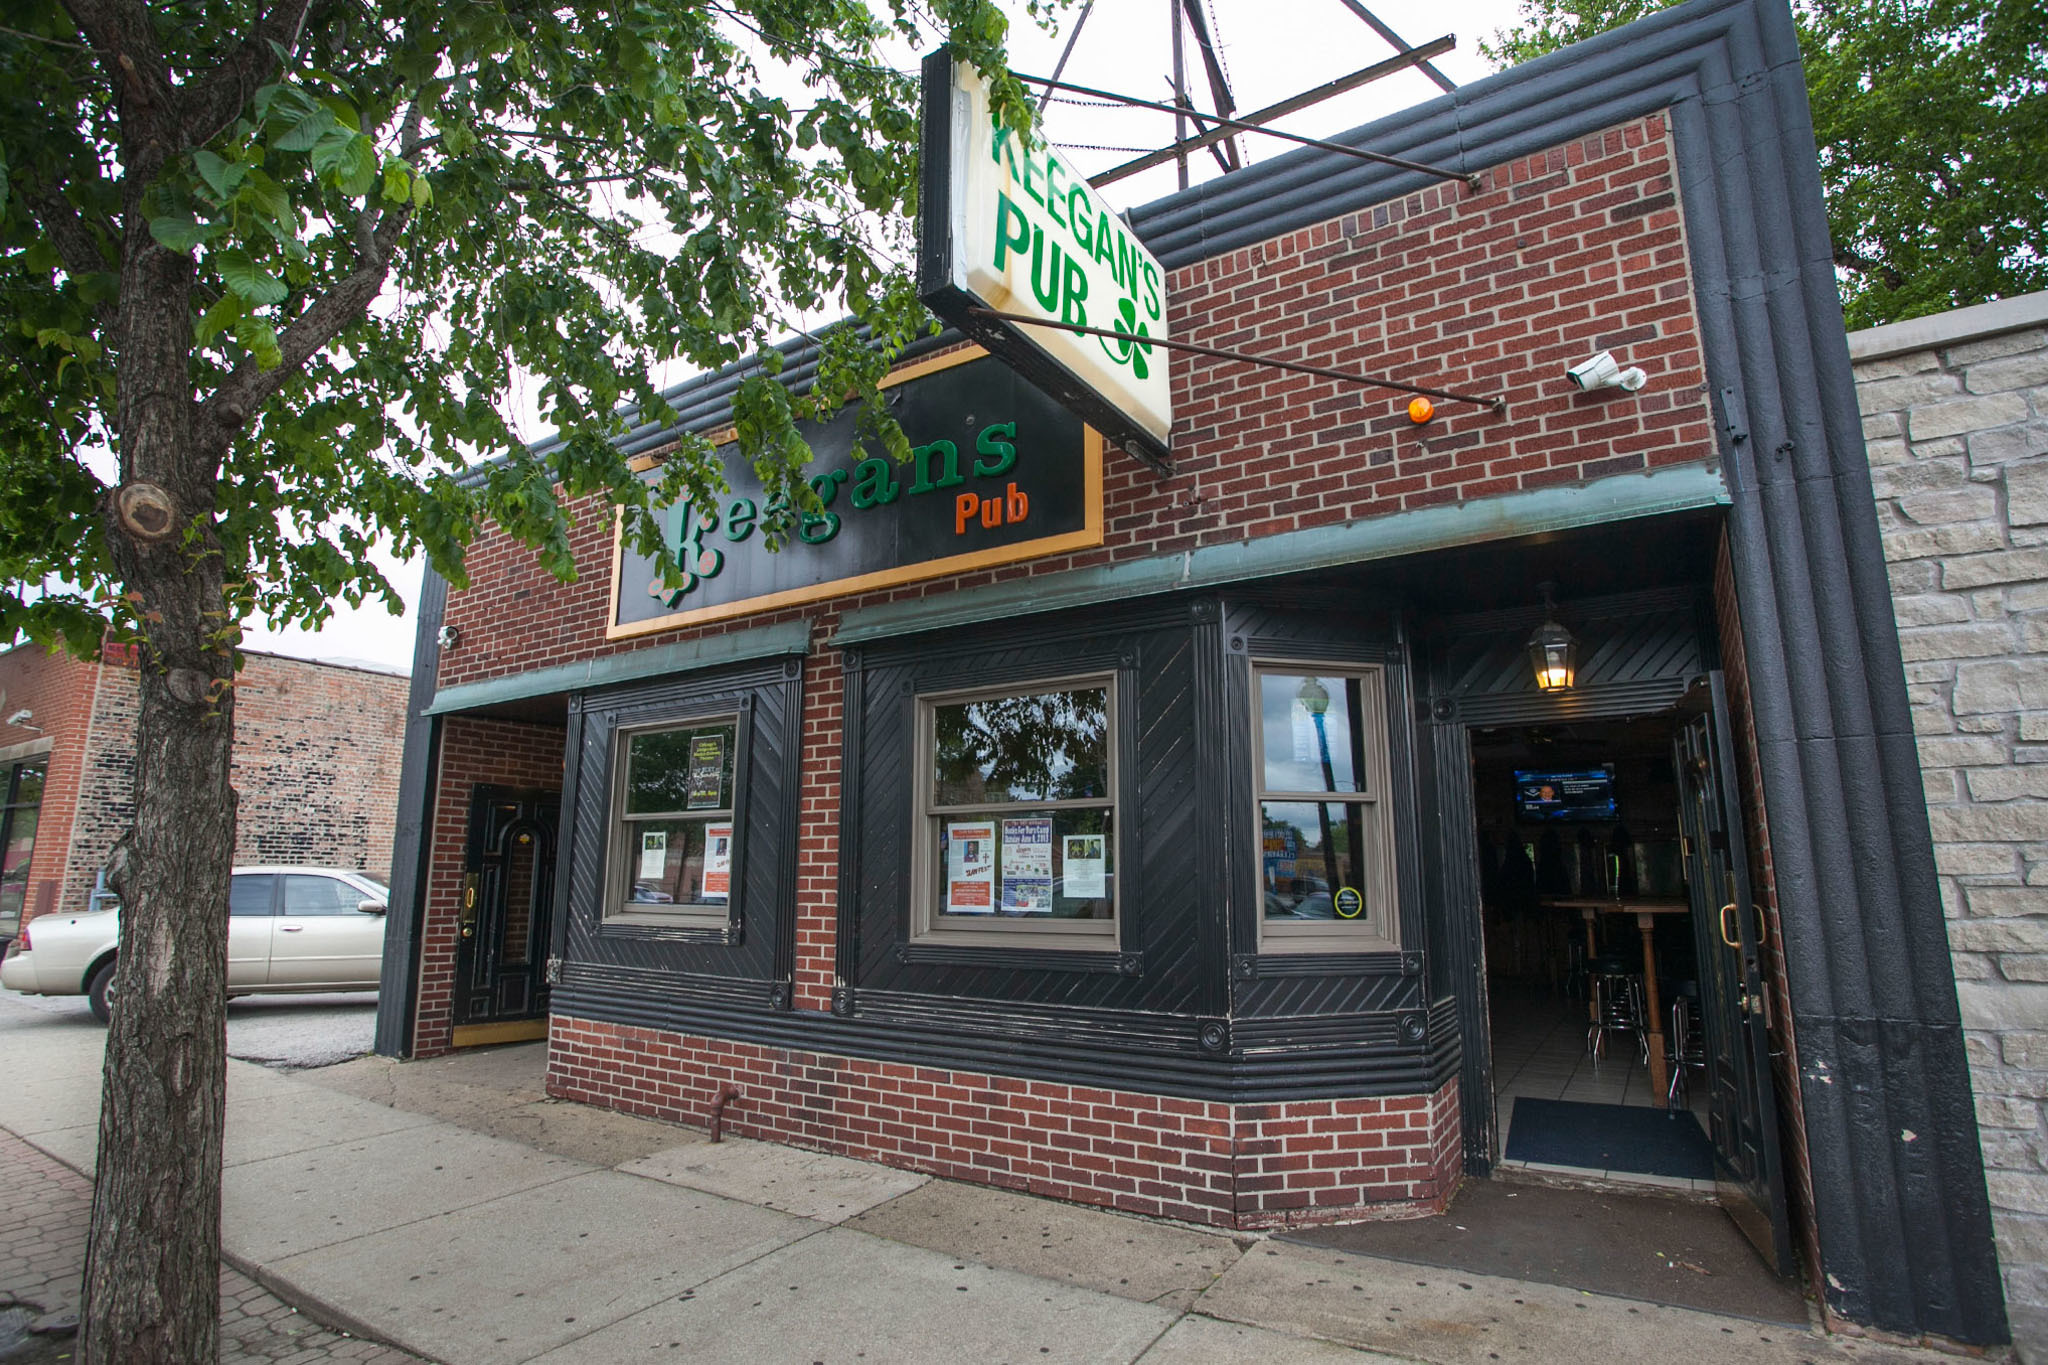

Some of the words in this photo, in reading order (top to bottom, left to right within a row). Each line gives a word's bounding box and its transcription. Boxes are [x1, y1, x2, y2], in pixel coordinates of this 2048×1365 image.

[991, 109, 1161, 322] KEEGAN'S
[993, 188, 1089, 338] PUB
[955, 482, 1030, 536] Pub
